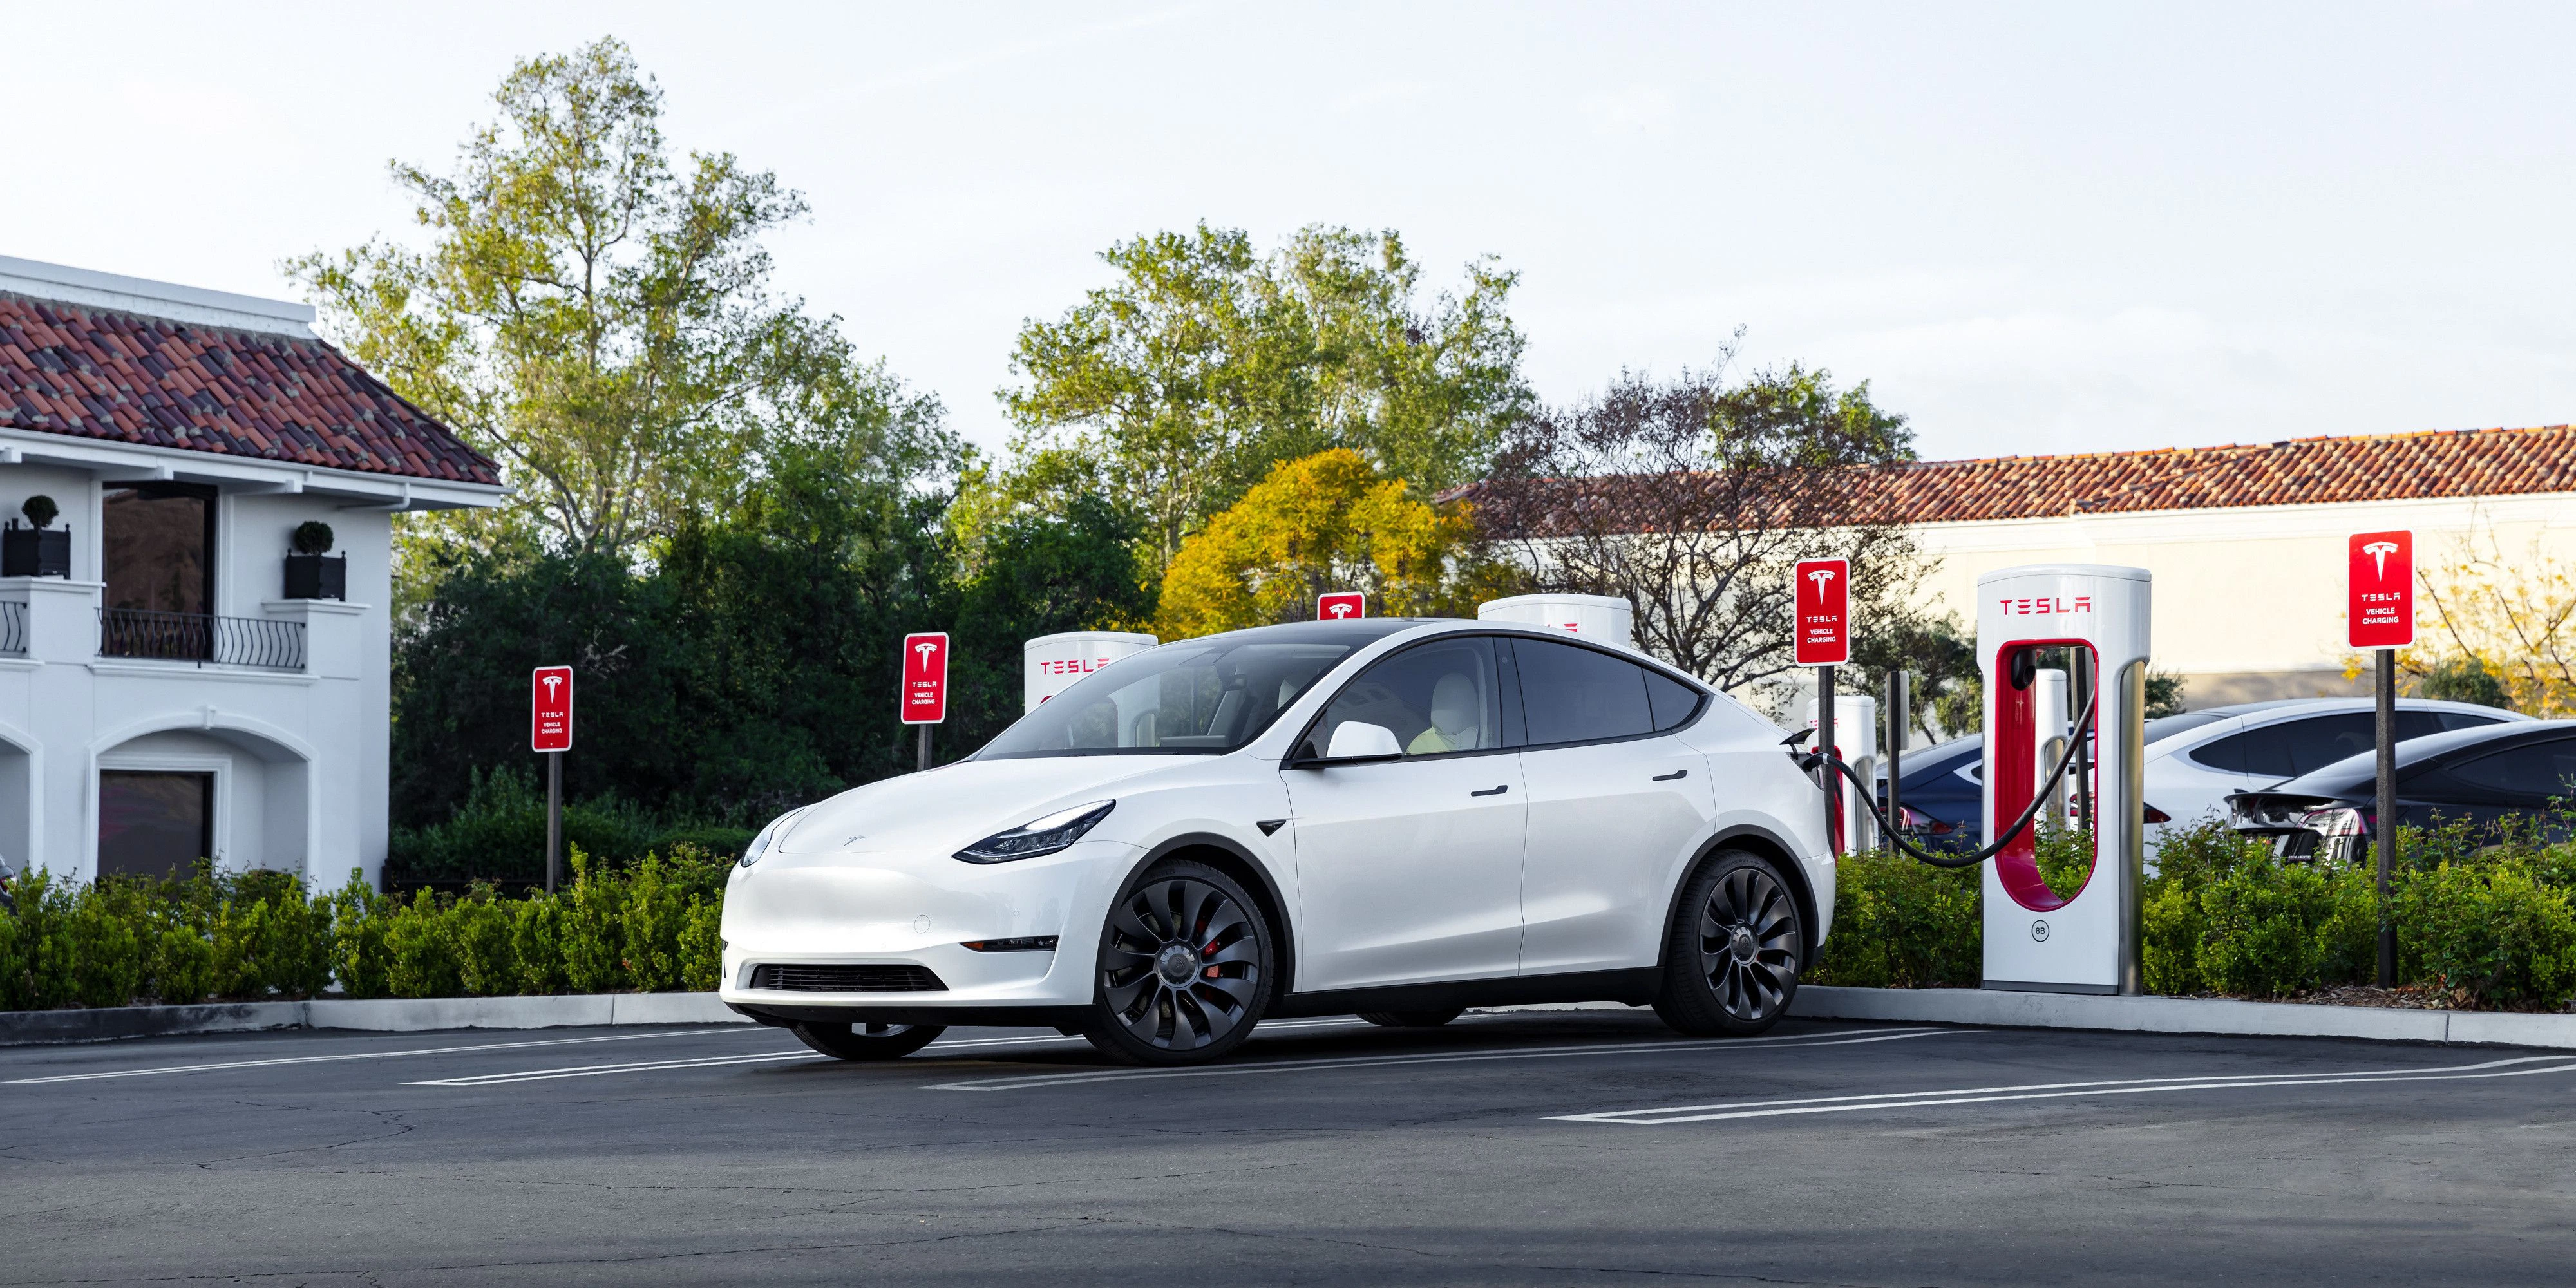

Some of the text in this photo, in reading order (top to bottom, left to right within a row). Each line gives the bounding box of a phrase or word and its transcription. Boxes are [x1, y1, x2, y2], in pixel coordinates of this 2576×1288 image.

[2361, 592, 2401, 602] TESLA
[2000, 596, 2091, 616] TESLA
[2365, 607, 2396, 616] VEHICLE
[2362, 616, 2400, 625] CHARGING
